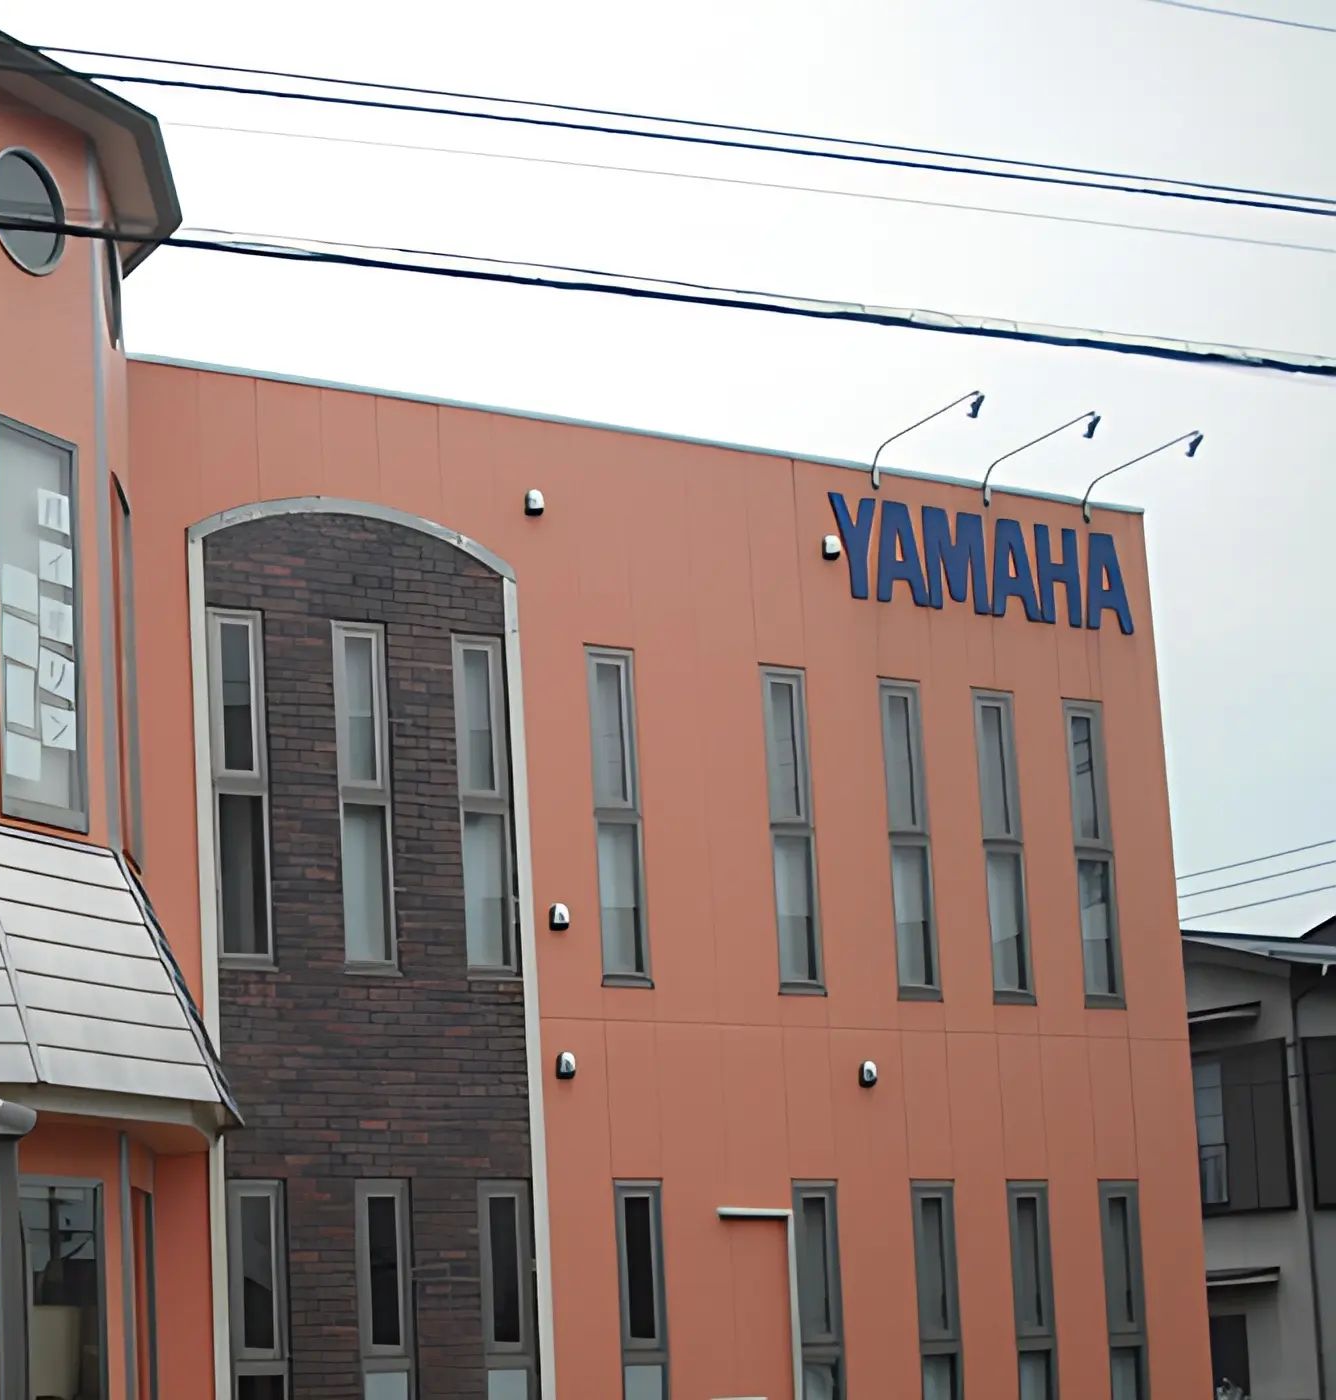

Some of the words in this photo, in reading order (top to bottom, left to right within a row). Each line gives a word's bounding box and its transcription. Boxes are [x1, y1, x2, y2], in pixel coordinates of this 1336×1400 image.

[44, 498, 70, 742] イリン
[828, 492, 1134, 635] YAMAHA
